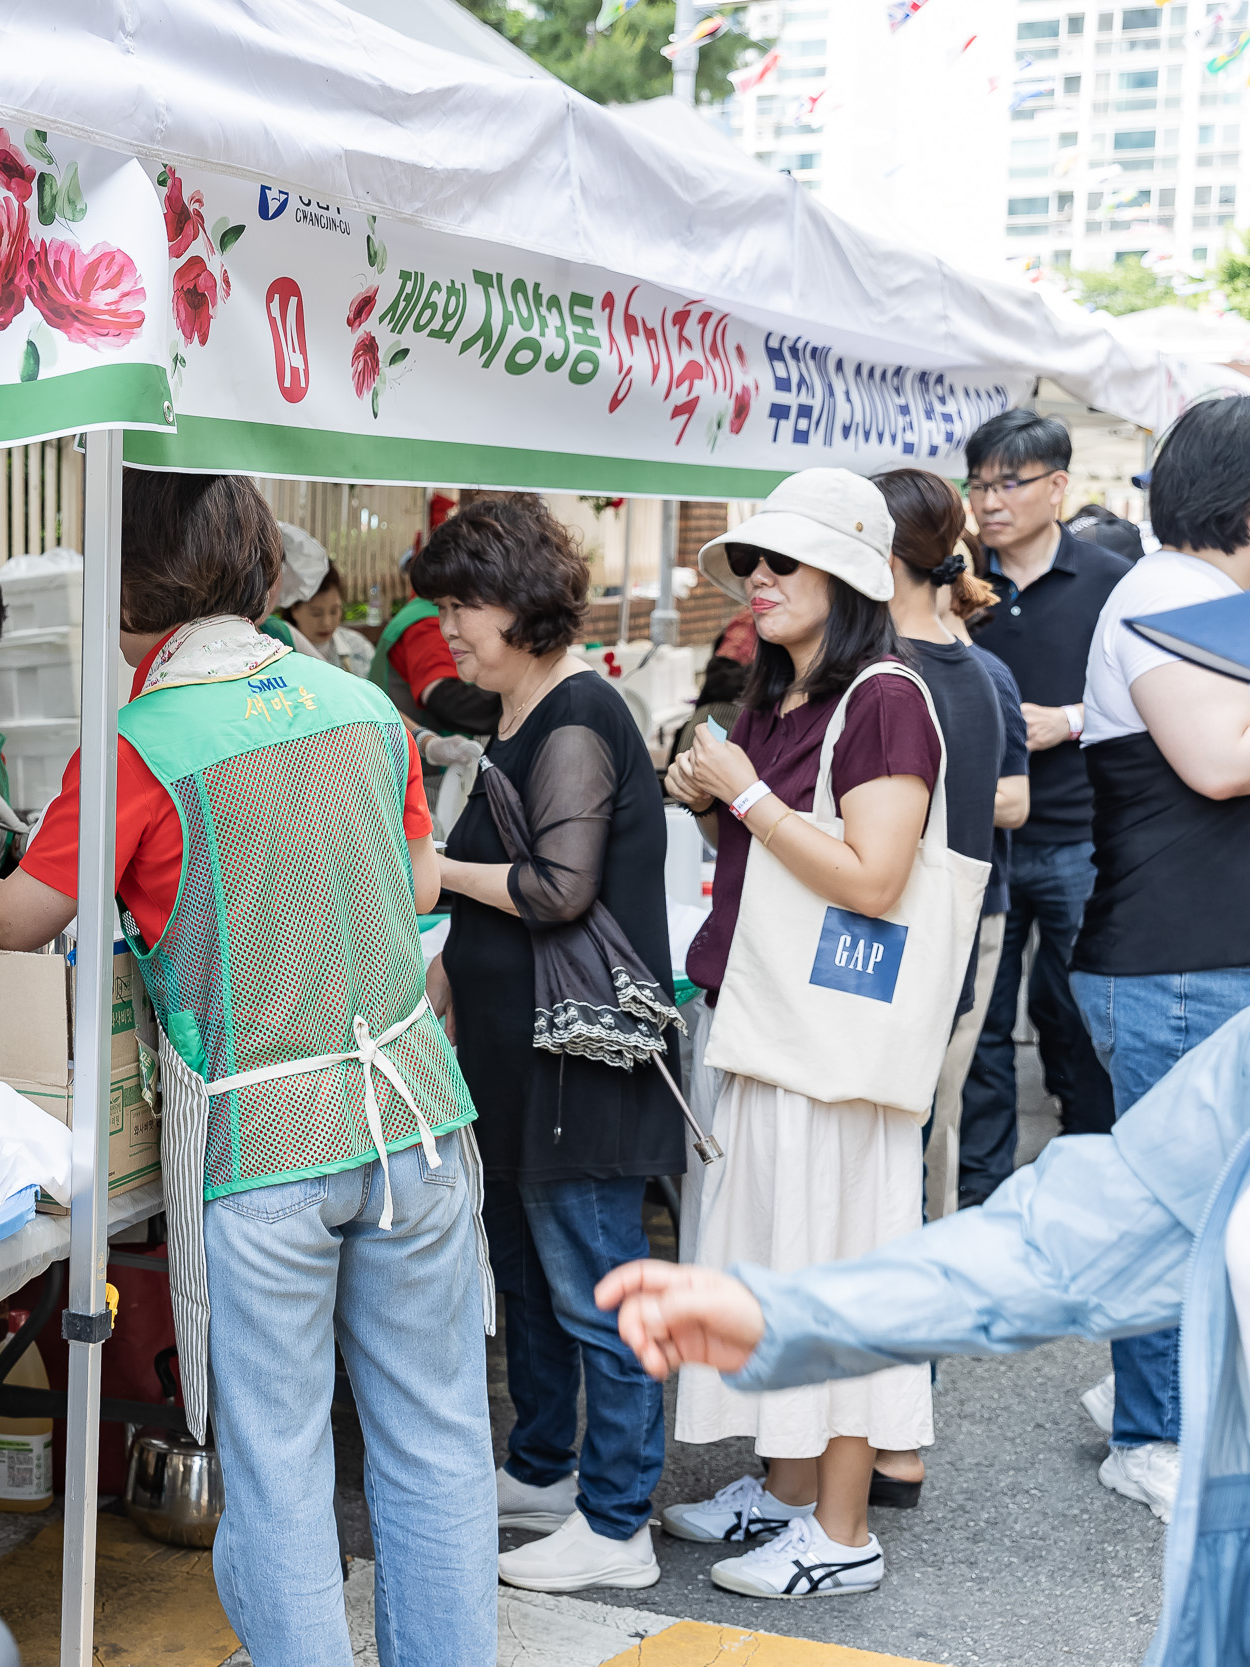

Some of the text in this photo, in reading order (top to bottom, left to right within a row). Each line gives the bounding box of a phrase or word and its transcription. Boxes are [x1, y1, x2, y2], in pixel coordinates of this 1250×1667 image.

[269, 294, 307, 389] 14
[378, 269, 467, 344] 제6회
[458, 268, 602, 386] 자양3동
[601, 284, 733, 446] 장미축제
[764, 331, 833, 448] 부침개
[244, 685, 318, 722] 새마을
[247, 676, 289, 694] SMU
[834, 934, 885, 975] GAP
